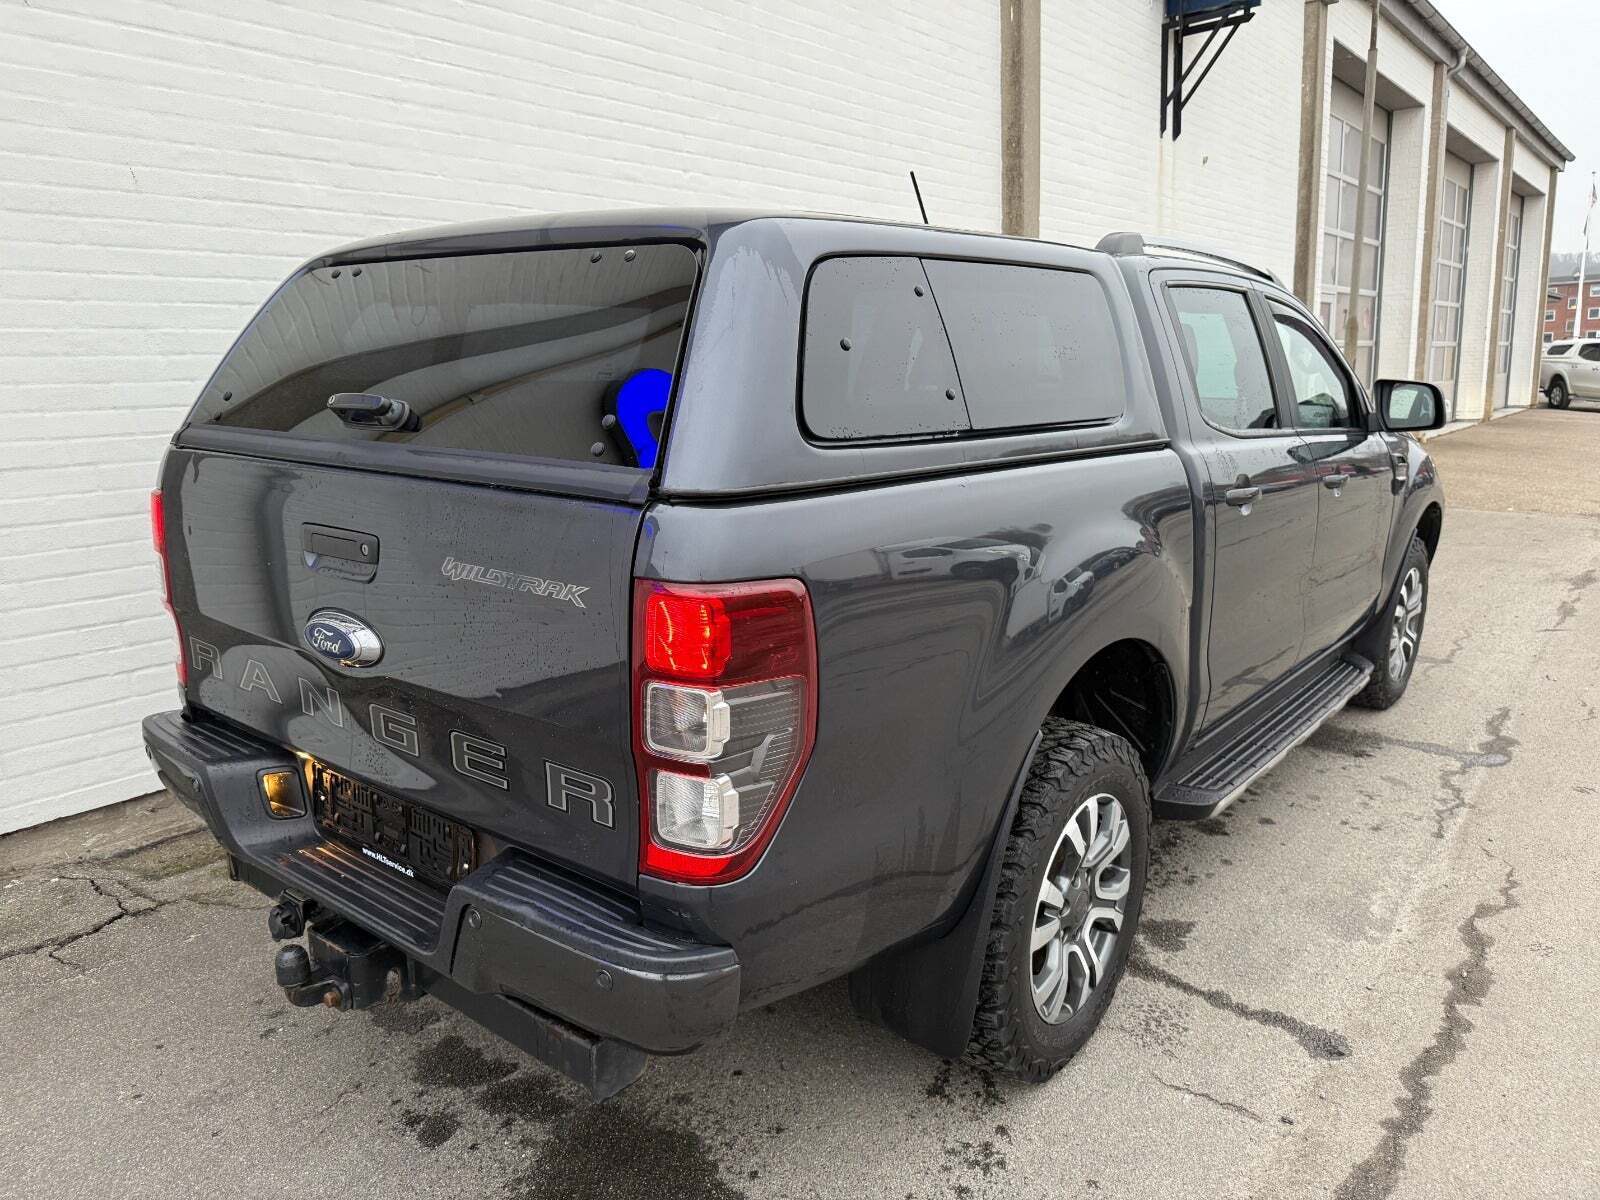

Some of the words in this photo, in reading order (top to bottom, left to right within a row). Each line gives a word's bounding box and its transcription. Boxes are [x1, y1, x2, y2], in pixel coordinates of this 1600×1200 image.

[441, 556, 591, 609] WILDTRAK
[312, 627, 342, 655] Ford
[190, 636, 613, 828] RANGER
